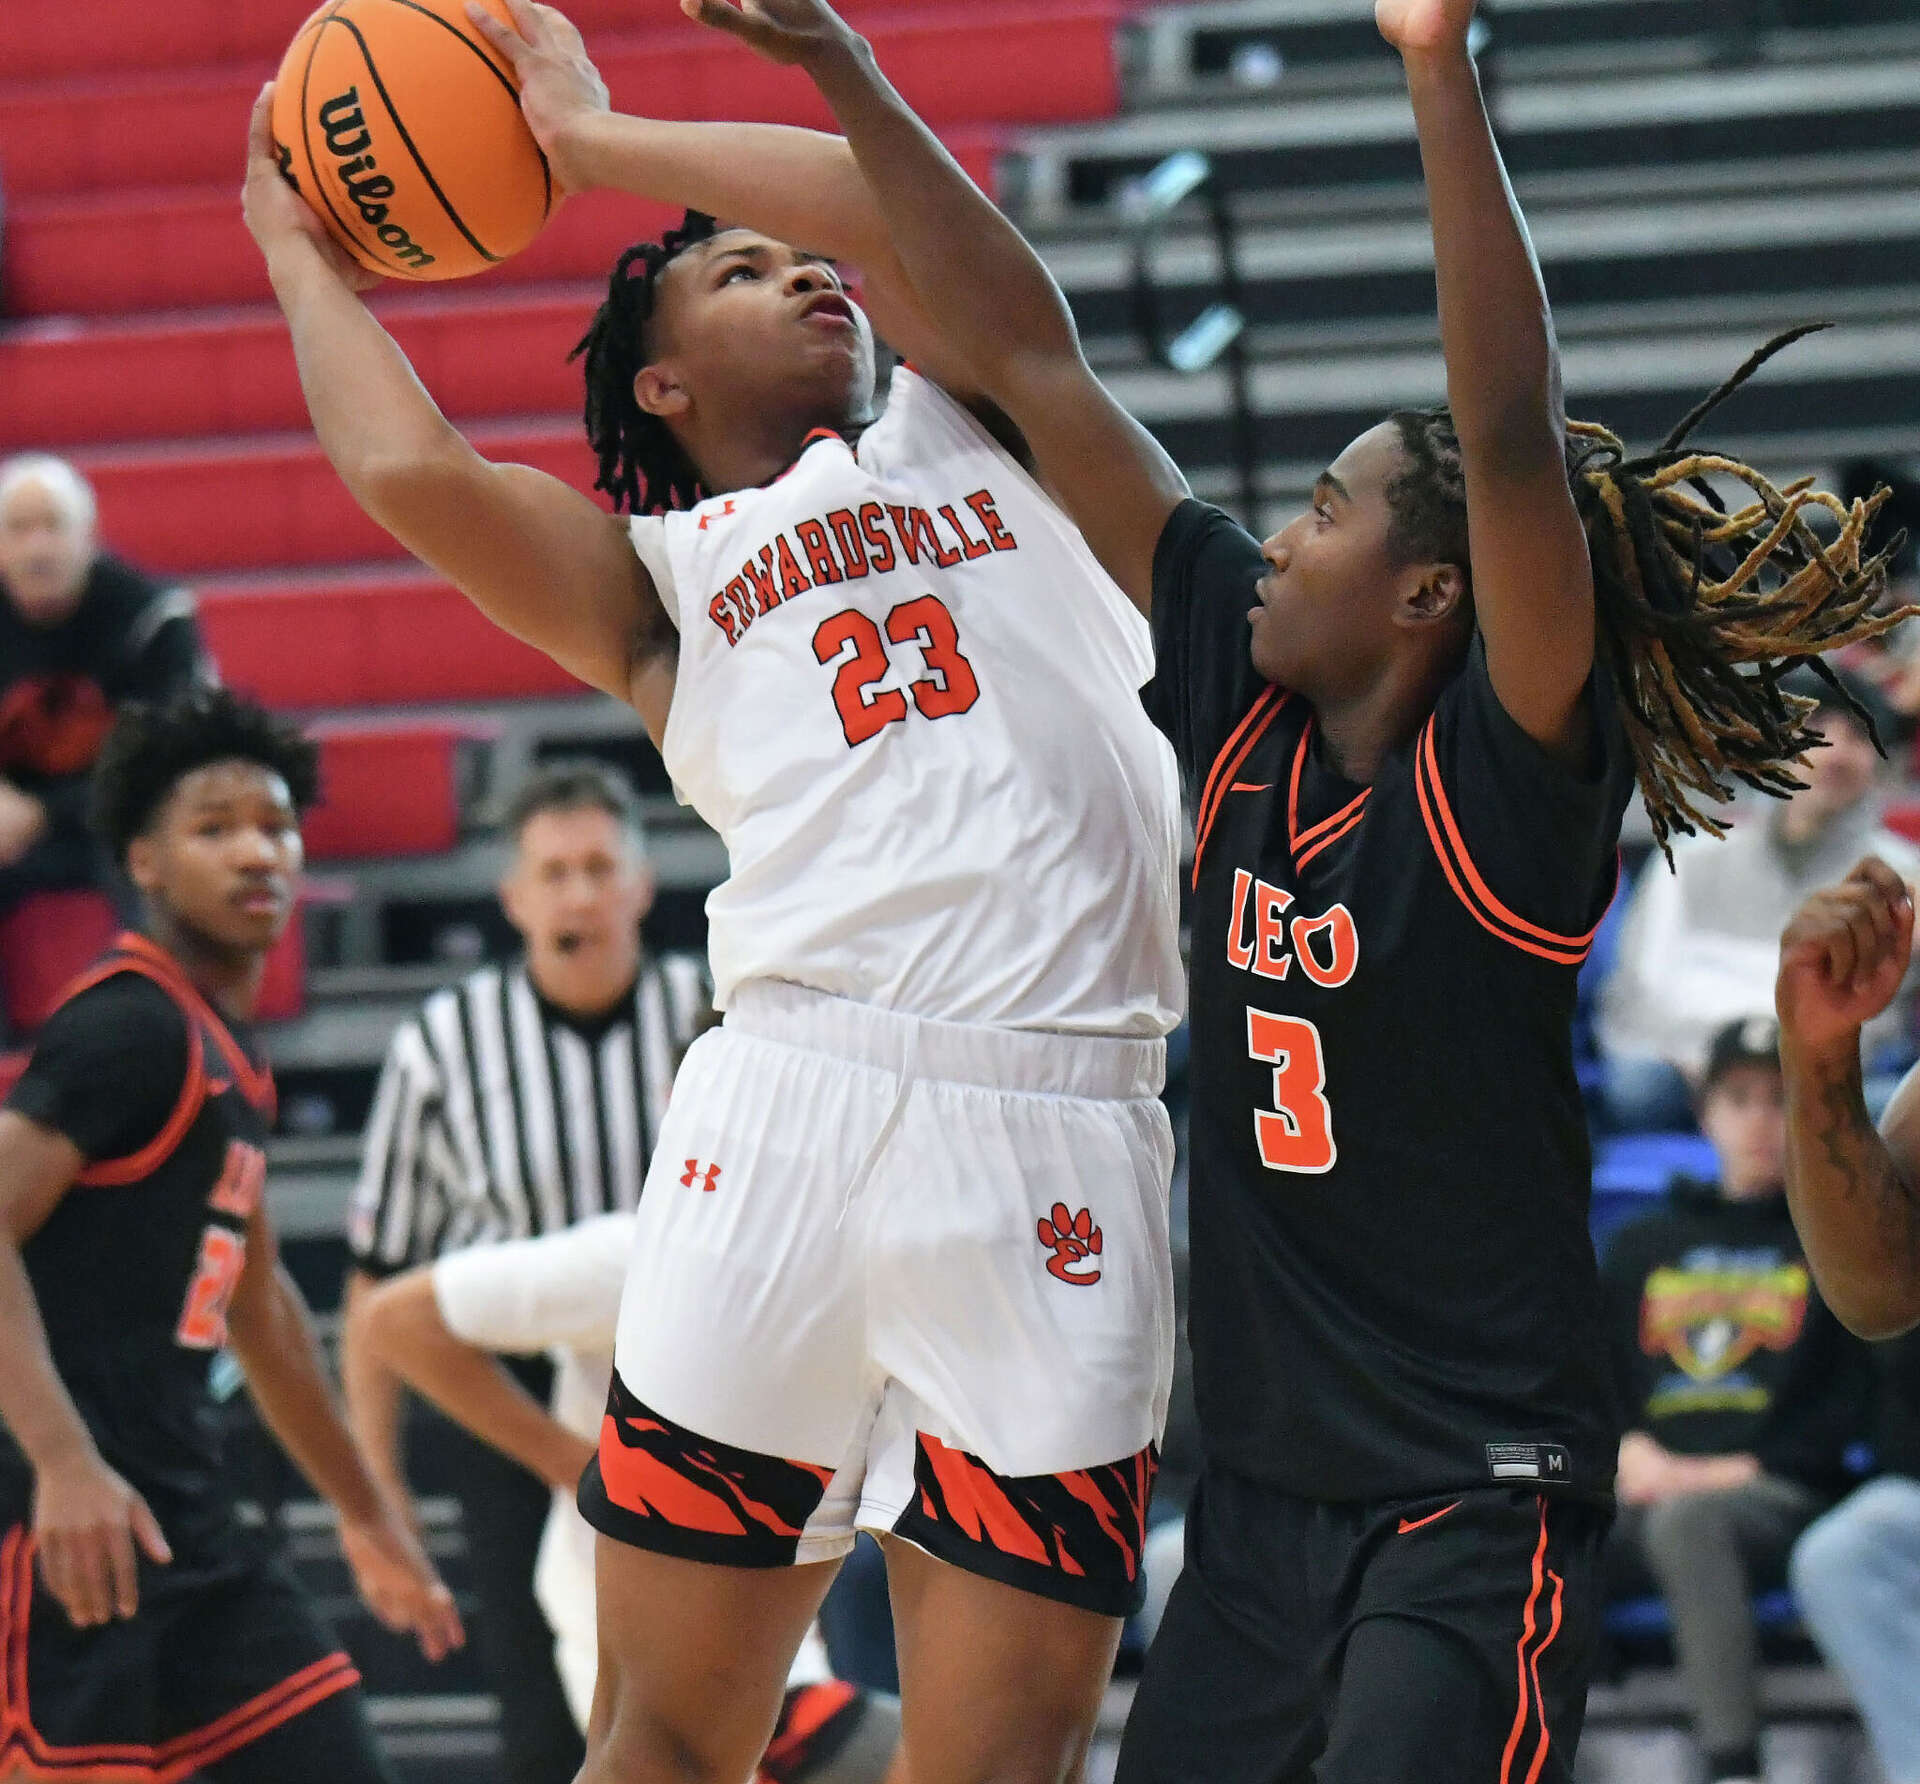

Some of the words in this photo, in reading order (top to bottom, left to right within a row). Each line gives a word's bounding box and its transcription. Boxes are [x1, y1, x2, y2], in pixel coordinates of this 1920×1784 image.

[319, 86, 435, 268] Wilson
[708, 489, 1017, 648] EDWARDSVLLE
[811, 594, 980, 748] 23
[1227, 867, 1359, 988] LEO
[1246, 1005, 1338, 1174] 3
[1548, 1454, 1563, 1471] M
